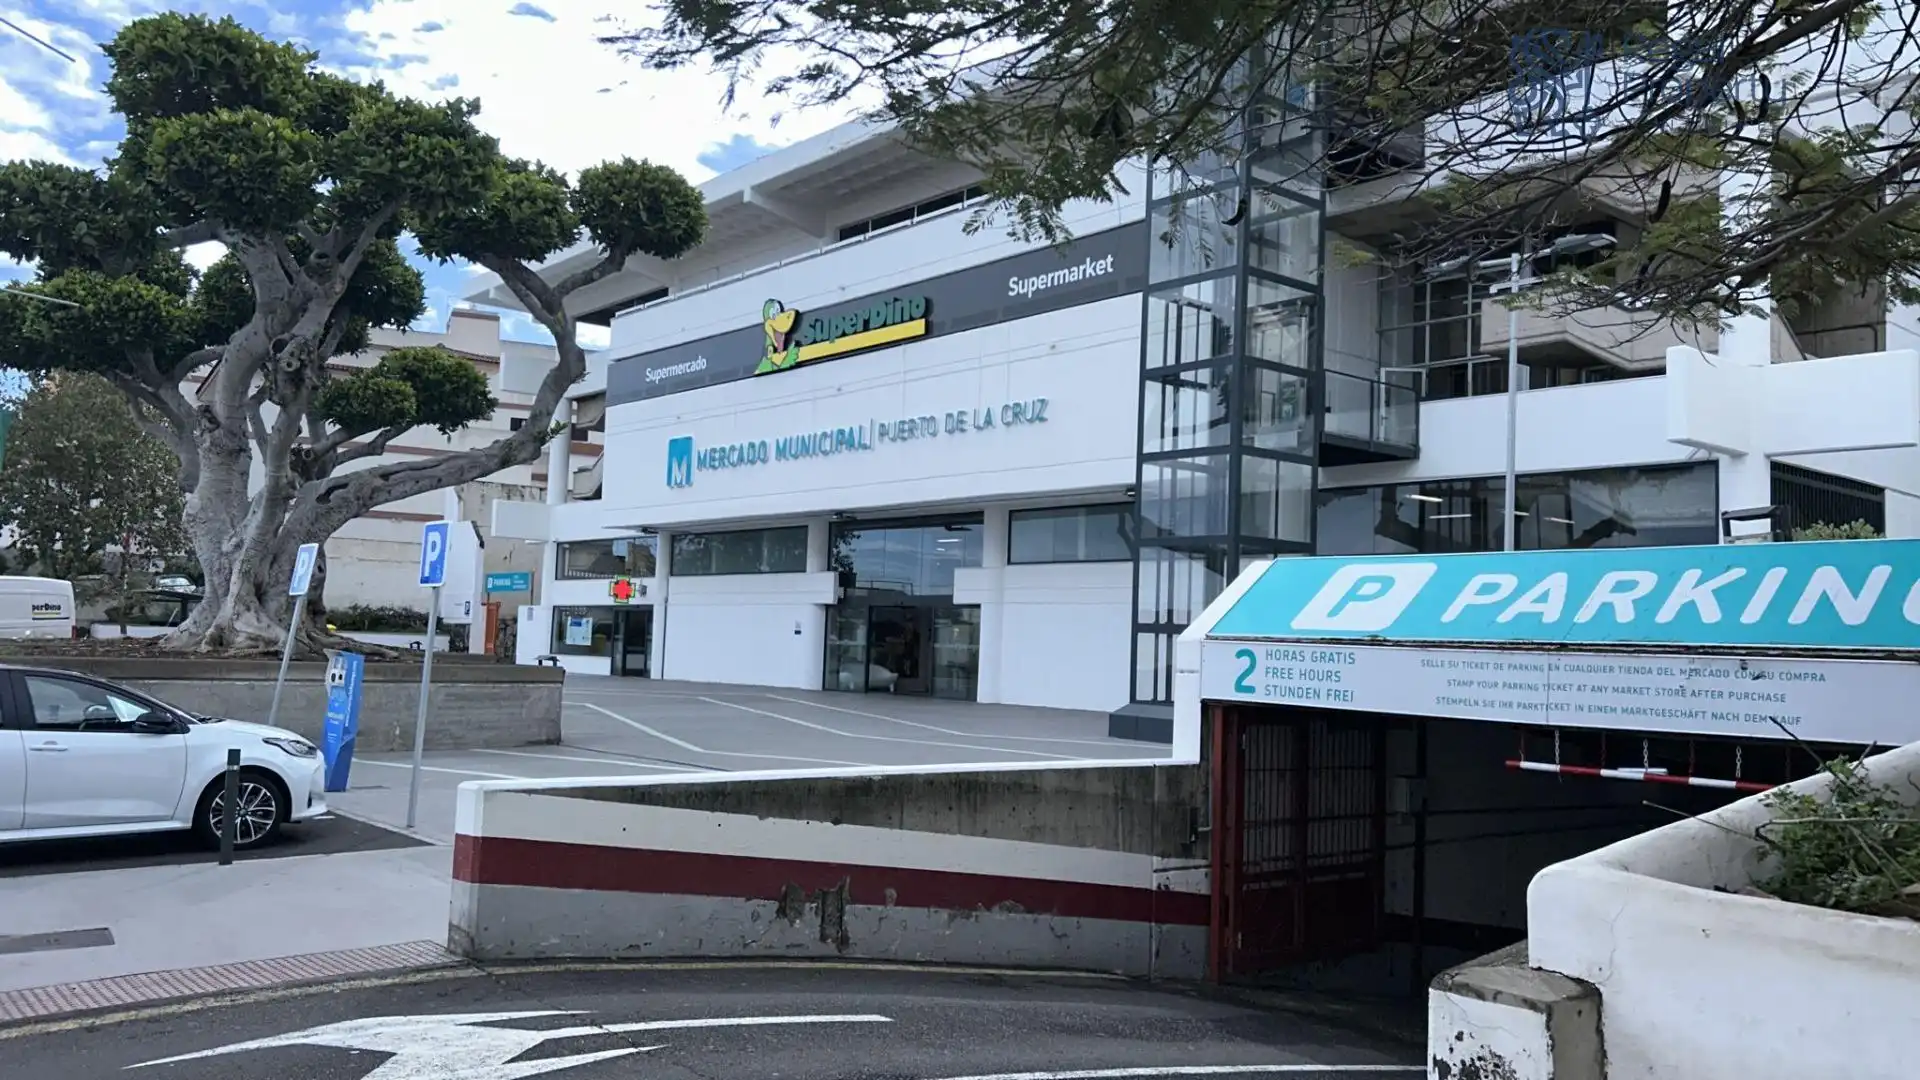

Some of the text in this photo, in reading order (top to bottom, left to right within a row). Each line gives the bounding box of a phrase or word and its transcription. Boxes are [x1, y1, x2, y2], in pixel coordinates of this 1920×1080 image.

[1008, 254, 1114, 298] Supermarket
[802, 296, 926, 344] SuperDino
[645, 355, 707, 384] Supermercado
[697, 398, 1049, 472] MERCADO MUNICIPAL PUERTO DE LA CRUZ
[294, 551, 309, 587] P
[424, 531, 441, 577] P
[1328, 575, 1397, 618] P
[1234, 648, 1257, 694] 2
[1265, 648, 1356, 665] HORAS GRATIS
[1420, 659, 1445, 669] SELLE
[1447, 660, 1459, 669] SU
[1462, 661, 1490, 671] TICKET
[1493, 662, 1504, 671] DE
[1508, 663, 1544, 673] PARKING
[1548, 663, 1560, 673] EN
[1563, 664, 1615, 675] CUALQUIER
[1618, 665, 1653, 676] TIENDA
[1657, 667, 1675, 677] DEL
[1680, 667, 1730, 679] MERCADO
[1734, 669, 1756, 680] CON
[1779, 671, 1826, 682] COMPRA
[1264, 666, 1341, 683] FREE HOURS
[1264, 684, 1355, 703] STUNDEN FREI
[1447, 679, 1787, 703] STAMP YOUR PARKING TICKET AT ANY MARKET STORE AFTER PURCHASE
[1435, 696, 1479, 708] STEMPELN
[1482, 698, 1495, 708] SIE
[1499, 700, 1514, 710] IHR
[1517, 701, 1571, 712] PARKTICKET
[1574, 703, 1584, 713] IN
[1588, 704, 1617, 715] EINEM
[1621, 705, 1707, 721] MARKTGESCHÄFT
[1711, 711, 1740, 722] NACH
[1744, 713, 1767, 724] DEM
